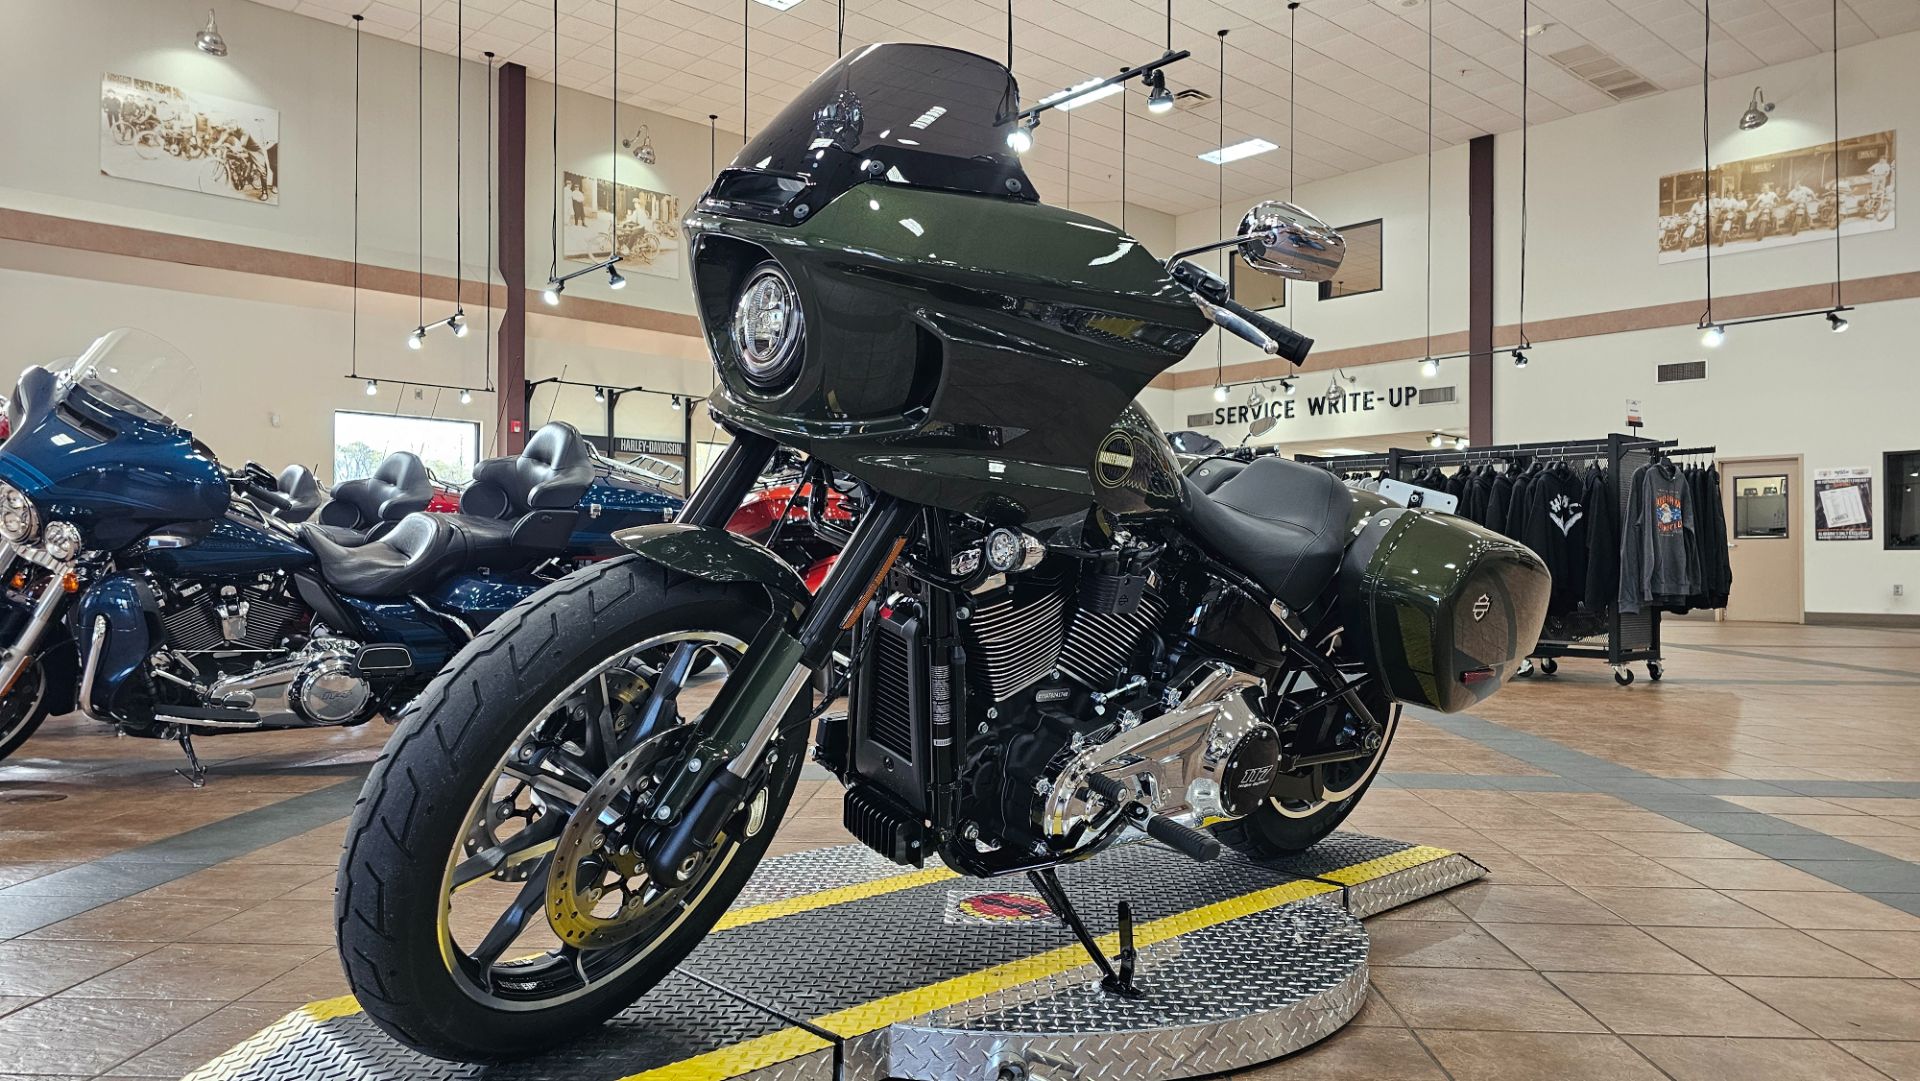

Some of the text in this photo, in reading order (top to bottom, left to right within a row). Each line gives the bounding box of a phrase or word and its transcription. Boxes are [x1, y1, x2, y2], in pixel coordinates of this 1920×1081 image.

[1215, 386, 1418, 425] SERVICE WRITE-UP
[620, 439, 683, 455] HARLEY-DAVIDSON
[1240, 764, 1274, 783] 117
